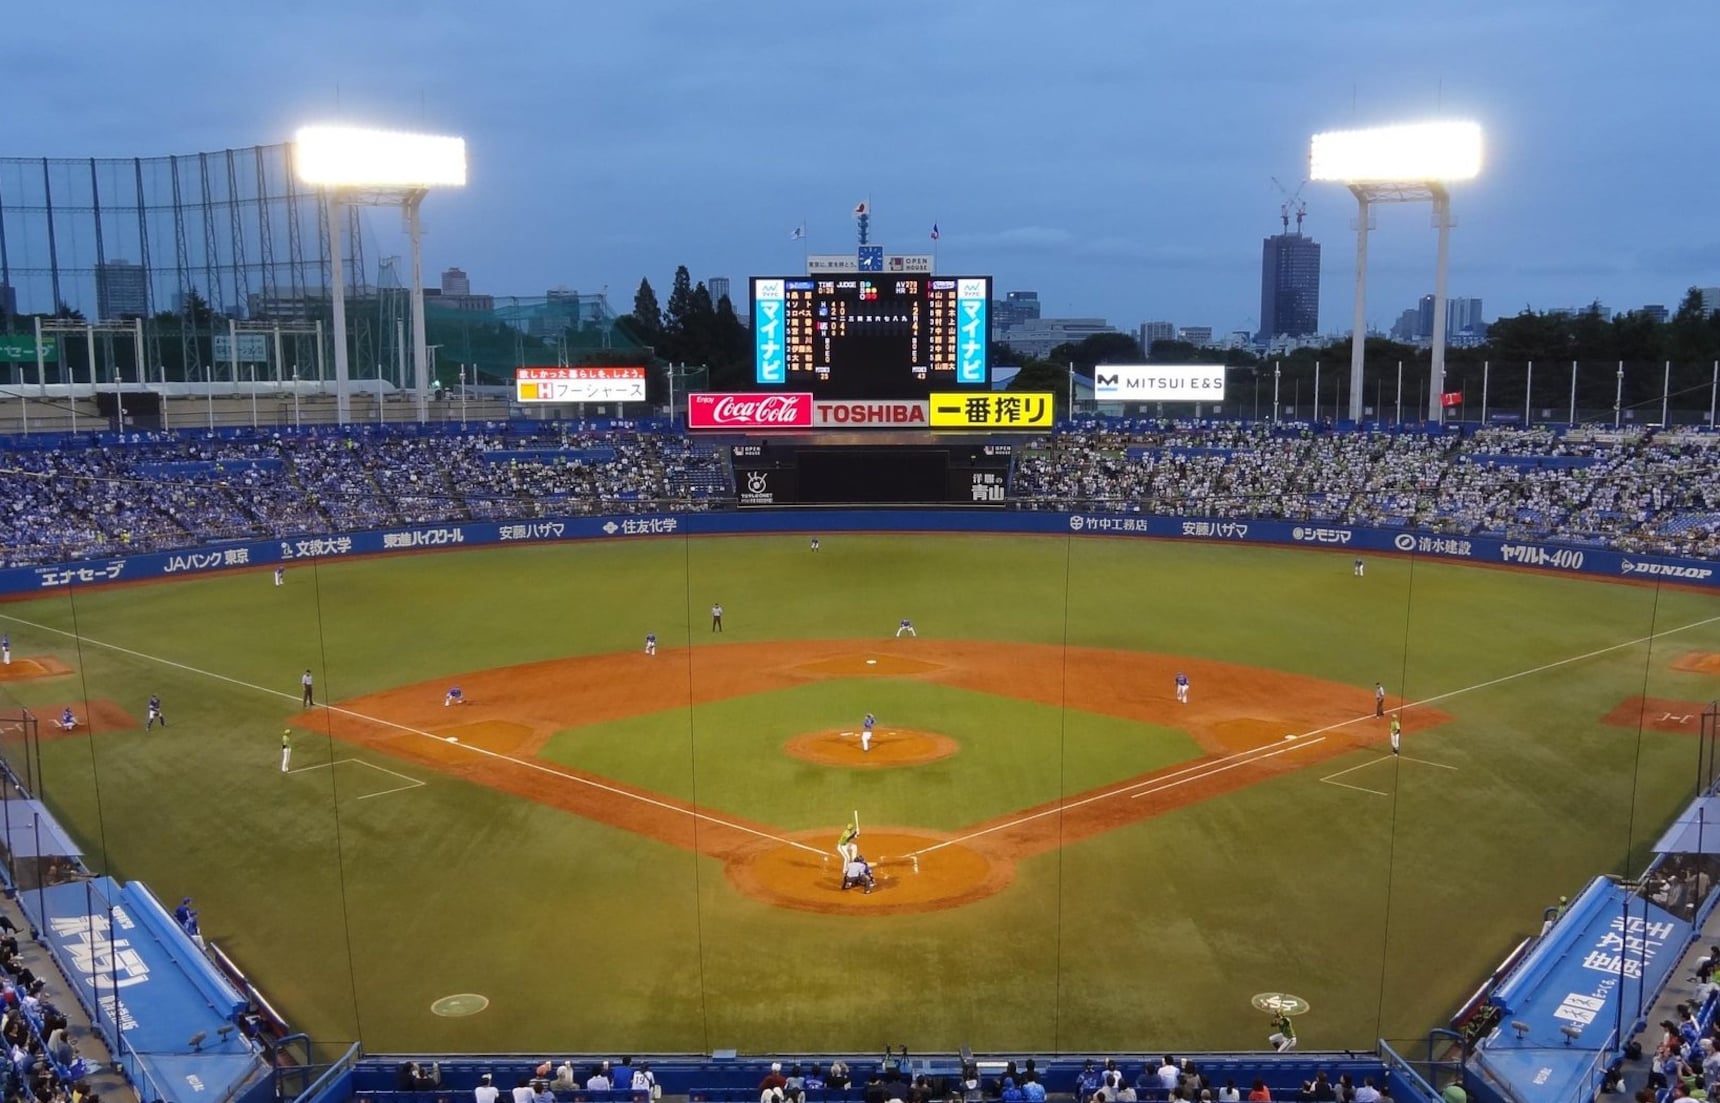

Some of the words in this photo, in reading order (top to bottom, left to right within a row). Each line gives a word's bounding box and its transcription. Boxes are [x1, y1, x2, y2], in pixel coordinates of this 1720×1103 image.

[761, 301, 780, 380] マイナビ
[962, 301, 981, 381] マイナビ
[558, 384, 642, 398] フーシャース
[1126, 378, 1185, 389] MITSUI
[1190, 378, 1222, 389] E&S
[696, 396, 715, 404] Enjoy
[713, 396, 800, 423] Coca-Cola
[818, 405, 925, 423] TOSHIBA
[937, 397, 1045, 423] 一番搾り
[971, 484, 1005, 500] 青山
[500, 521, 564, 540] 安藤ハザマ
[622, 518, 677, 534] 住友化学
[1086, 517, 1148, 532] 竹中工務店
[1182, 521, 1248, 539] 安藤ハザマ
[296, 537, 352, 557] 文教大学
[383, 527, 464, 549] 東進ハイスクール
[1419, 535, 1472, 556] 清水建設
[163, 551, 221, 573] JAバンク
[224, 547, 249, 565] 東京
[1500, 544, 1584, 570] ヤクルト400
[41, 563, 124, 586] エナセーブ
[1634, 563, 1713, 579] DUNLOP
[635, 1076, 645, 1085] 19
